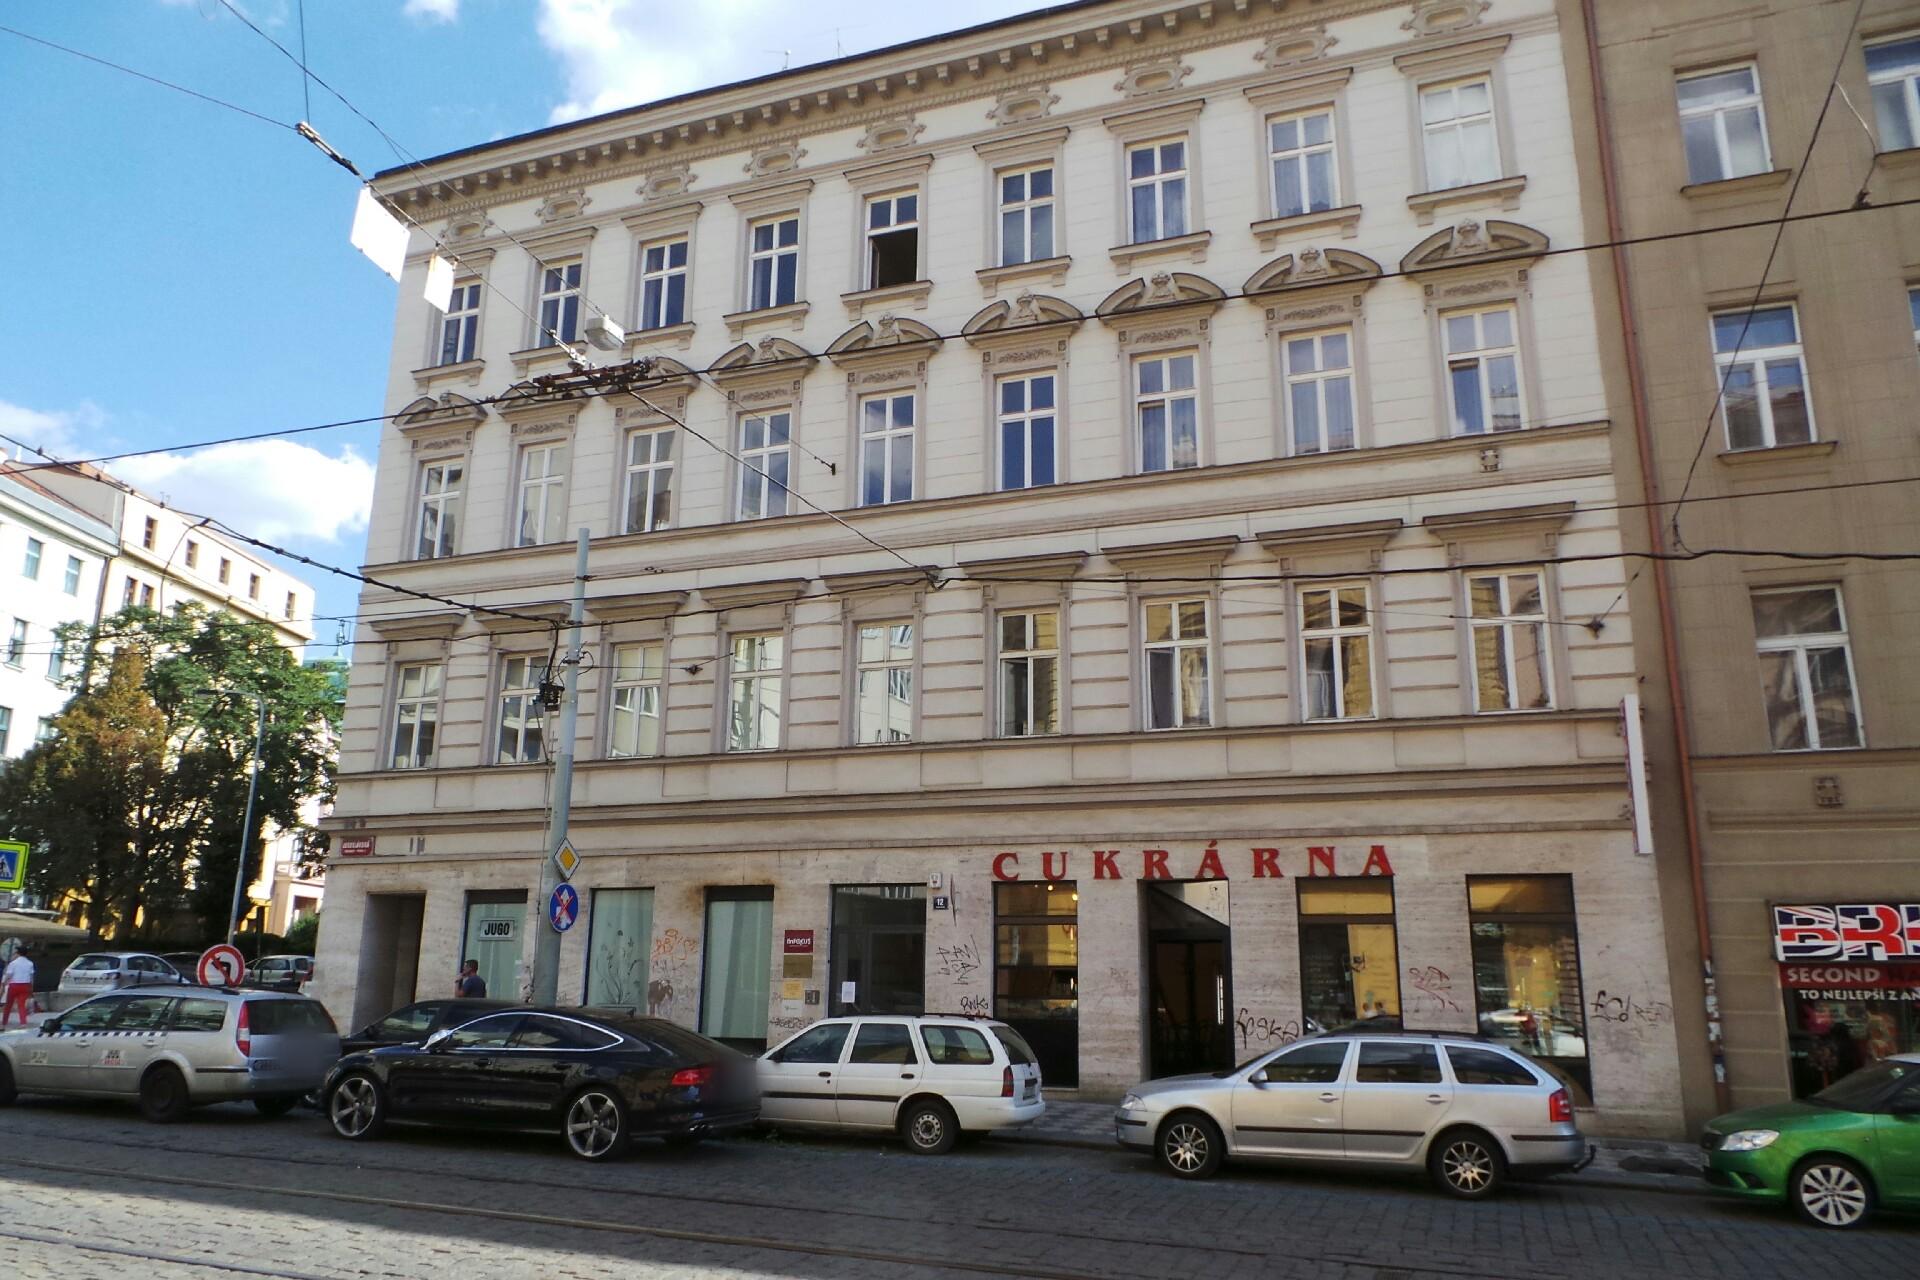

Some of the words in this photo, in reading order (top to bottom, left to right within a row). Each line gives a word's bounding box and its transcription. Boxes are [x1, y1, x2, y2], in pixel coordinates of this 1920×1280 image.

[992, 840, 1396, 881] CUKRÁRNA
[937, 898, 944, 906] 12
[484, 922, 510, 936] JUGO
[1787, 967, 1880, 982] SECOND
[1799, 989, 1820, 1000] TO
[1888, 989, 1898, 1000] Z
